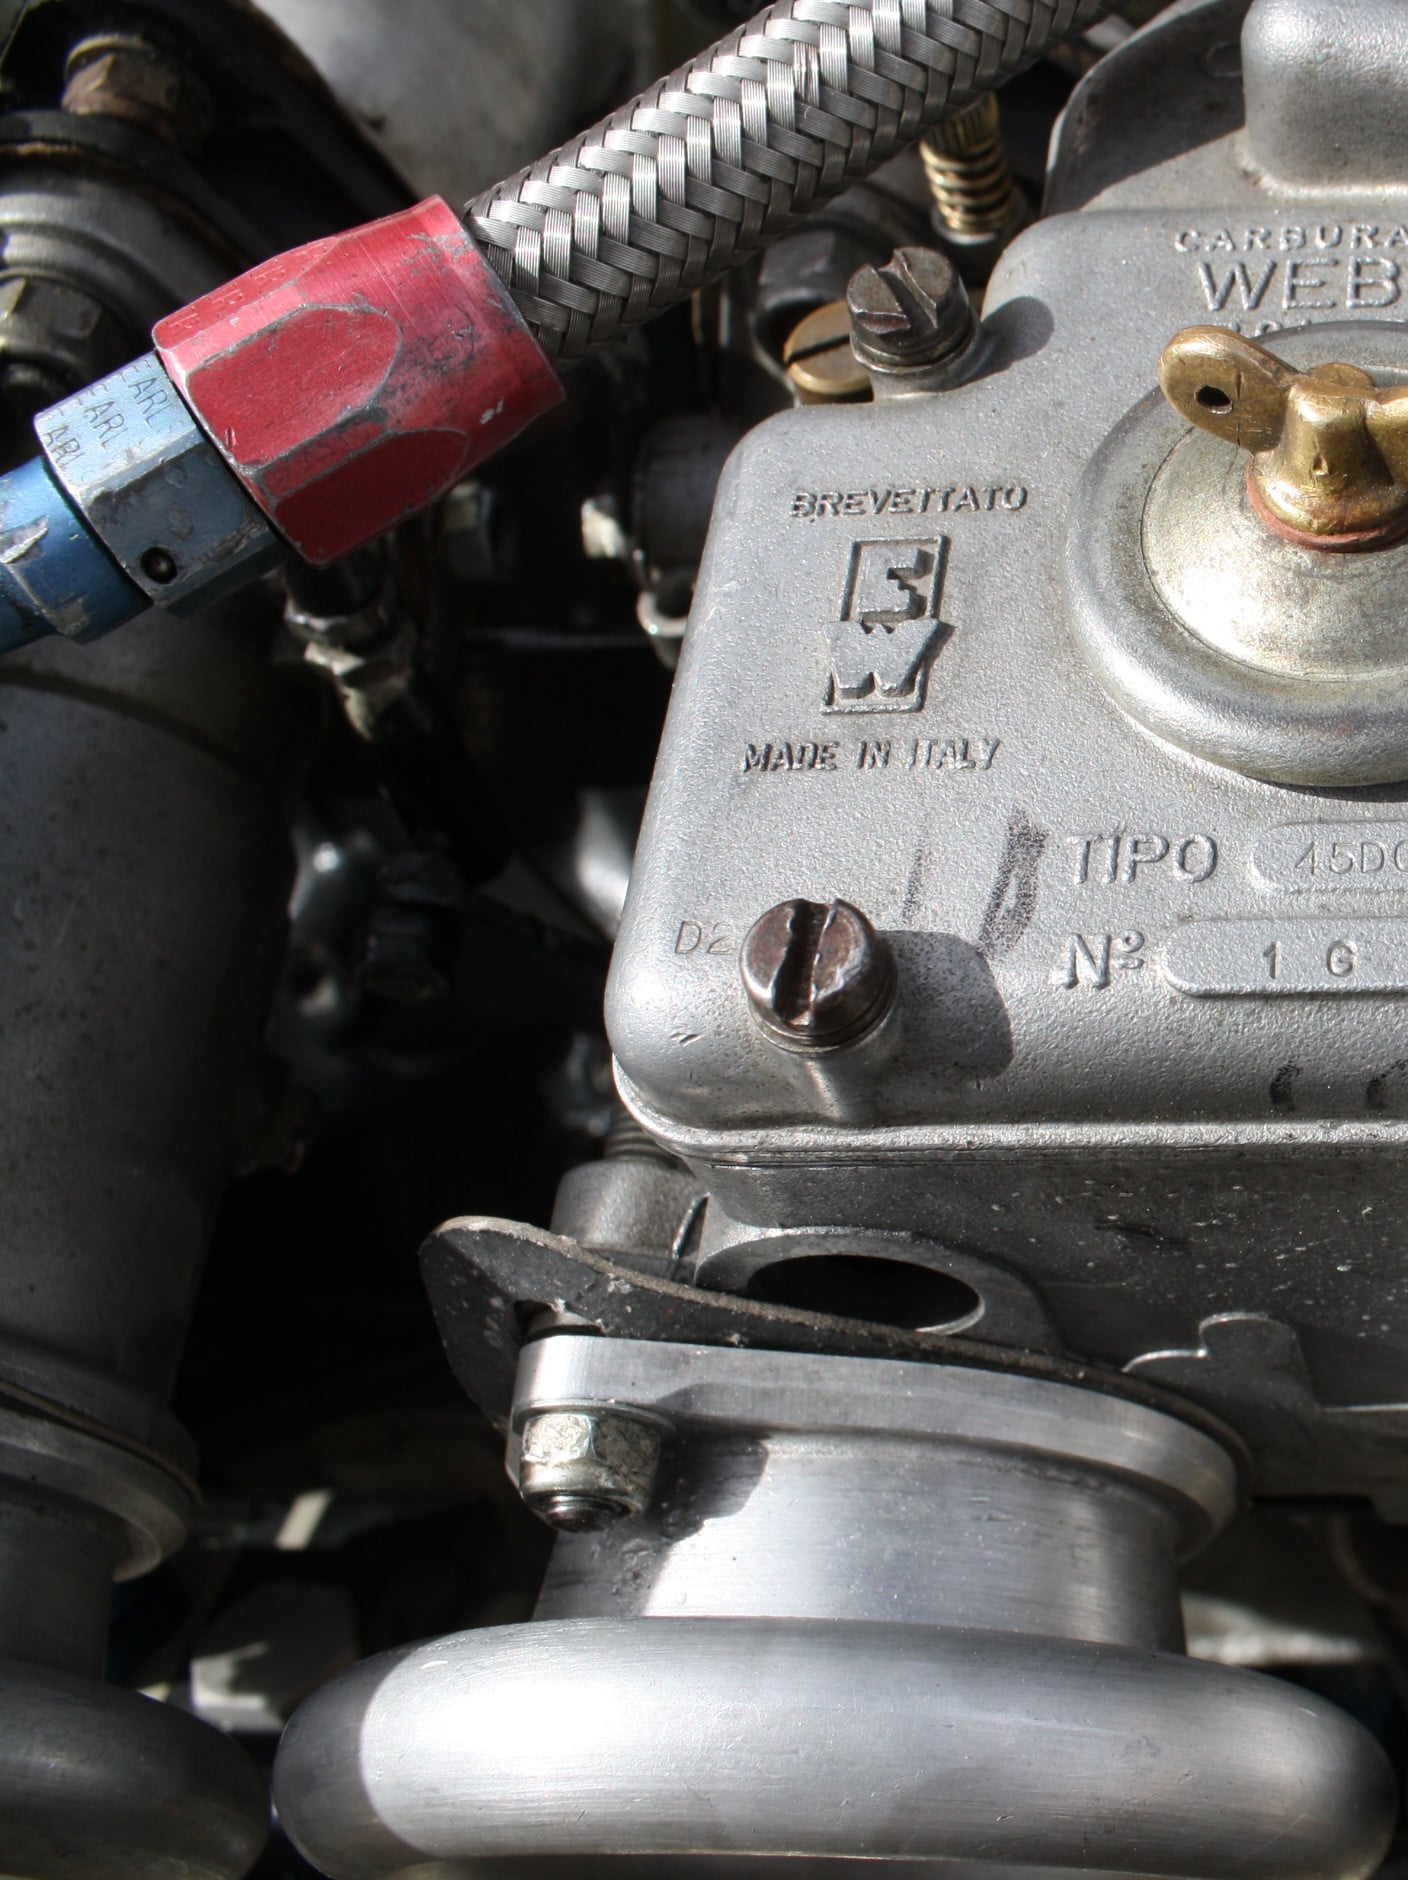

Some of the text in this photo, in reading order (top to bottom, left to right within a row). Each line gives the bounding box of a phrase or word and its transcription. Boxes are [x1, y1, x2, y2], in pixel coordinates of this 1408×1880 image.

[789, 486, 1029, 518] BREVETTATO
[742, 737, 1001, 773] MADE IN ITALY
[1066, 832, 1219, 885] TIPO
[673, 919, 737, 956] D2
